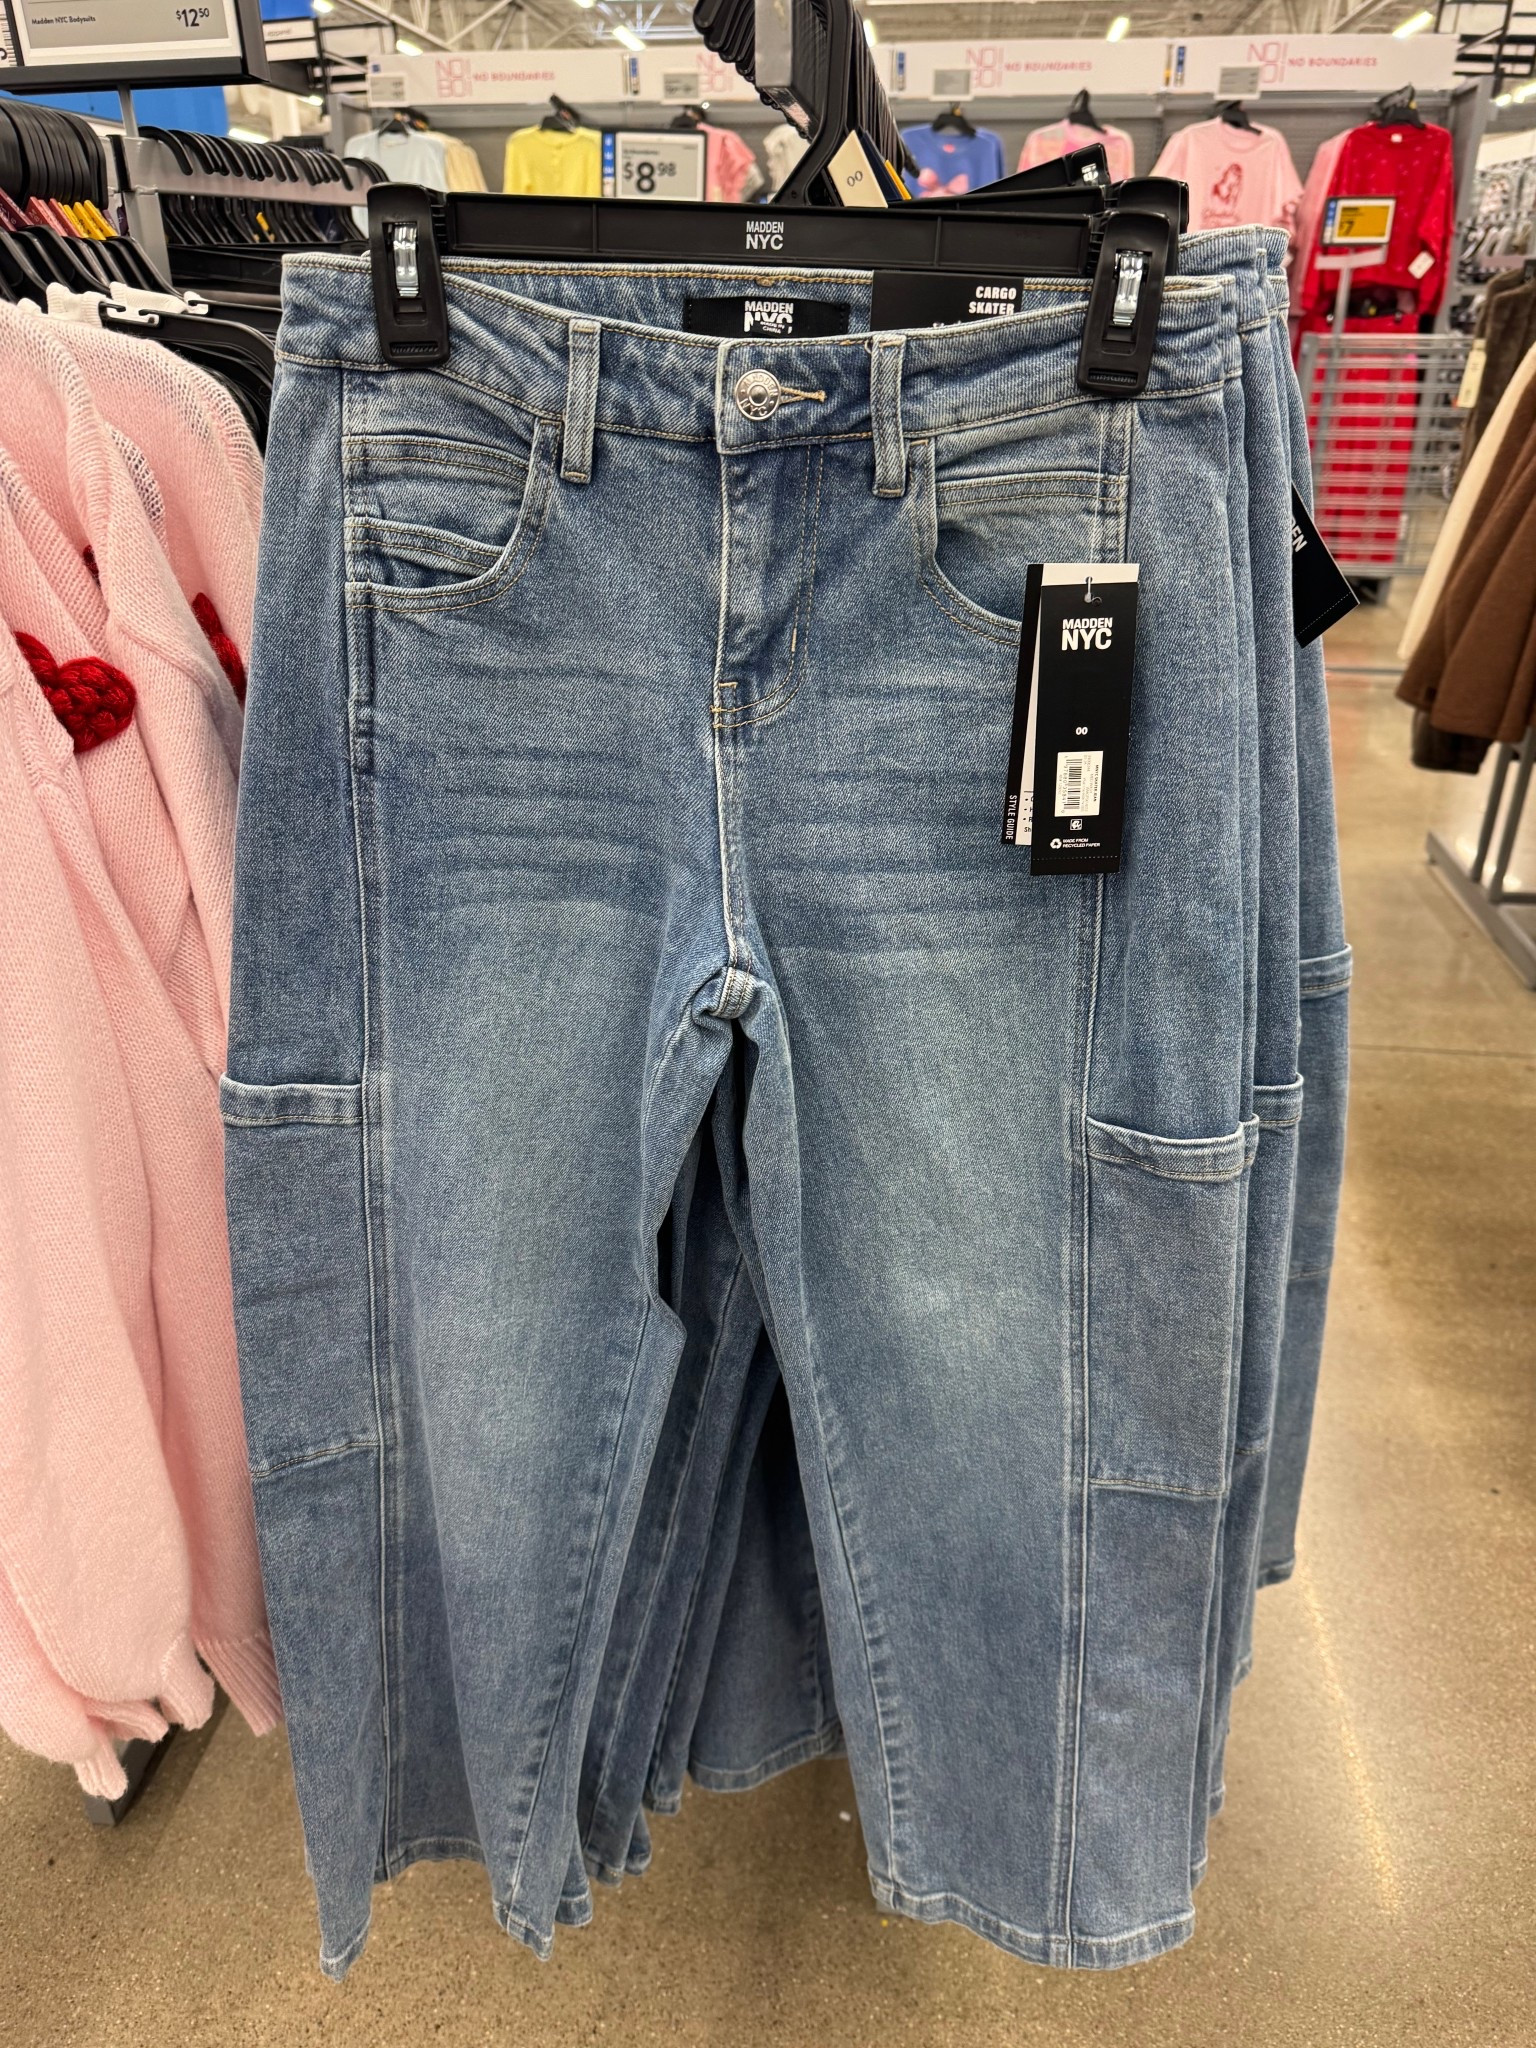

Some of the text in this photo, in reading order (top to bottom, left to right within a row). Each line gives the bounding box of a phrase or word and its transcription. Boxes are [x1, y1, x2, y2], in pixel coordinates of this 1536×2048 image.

[31, 15, 96, 25] Madden NYC Bodysuits
[1005, 61, 1093, 72] NO BOUNDARIES
[1287, 57, 1378, 67] NO BOUNDARIES
[491, 70, 555, 81] BOUNDARIES
[746, 220, 784, 233] MADDEN
[746, 234, 784, 250] NYC
[975, 286, 1017, 300] CARGO
[744, 300, 794, 314] MADDEN
[968, 301, 1015, 315] SKATER
[762, 325, 781, 334] CHINA
[739, 398, 768, 416] NYC
[1062, 617, 1113, 630] MADDEN
[1061, 627, 1112, 651] NYC
[1075, 726, 1088, 736] 00
[1005, 794, 1018, 840] STYLE GUIDE
